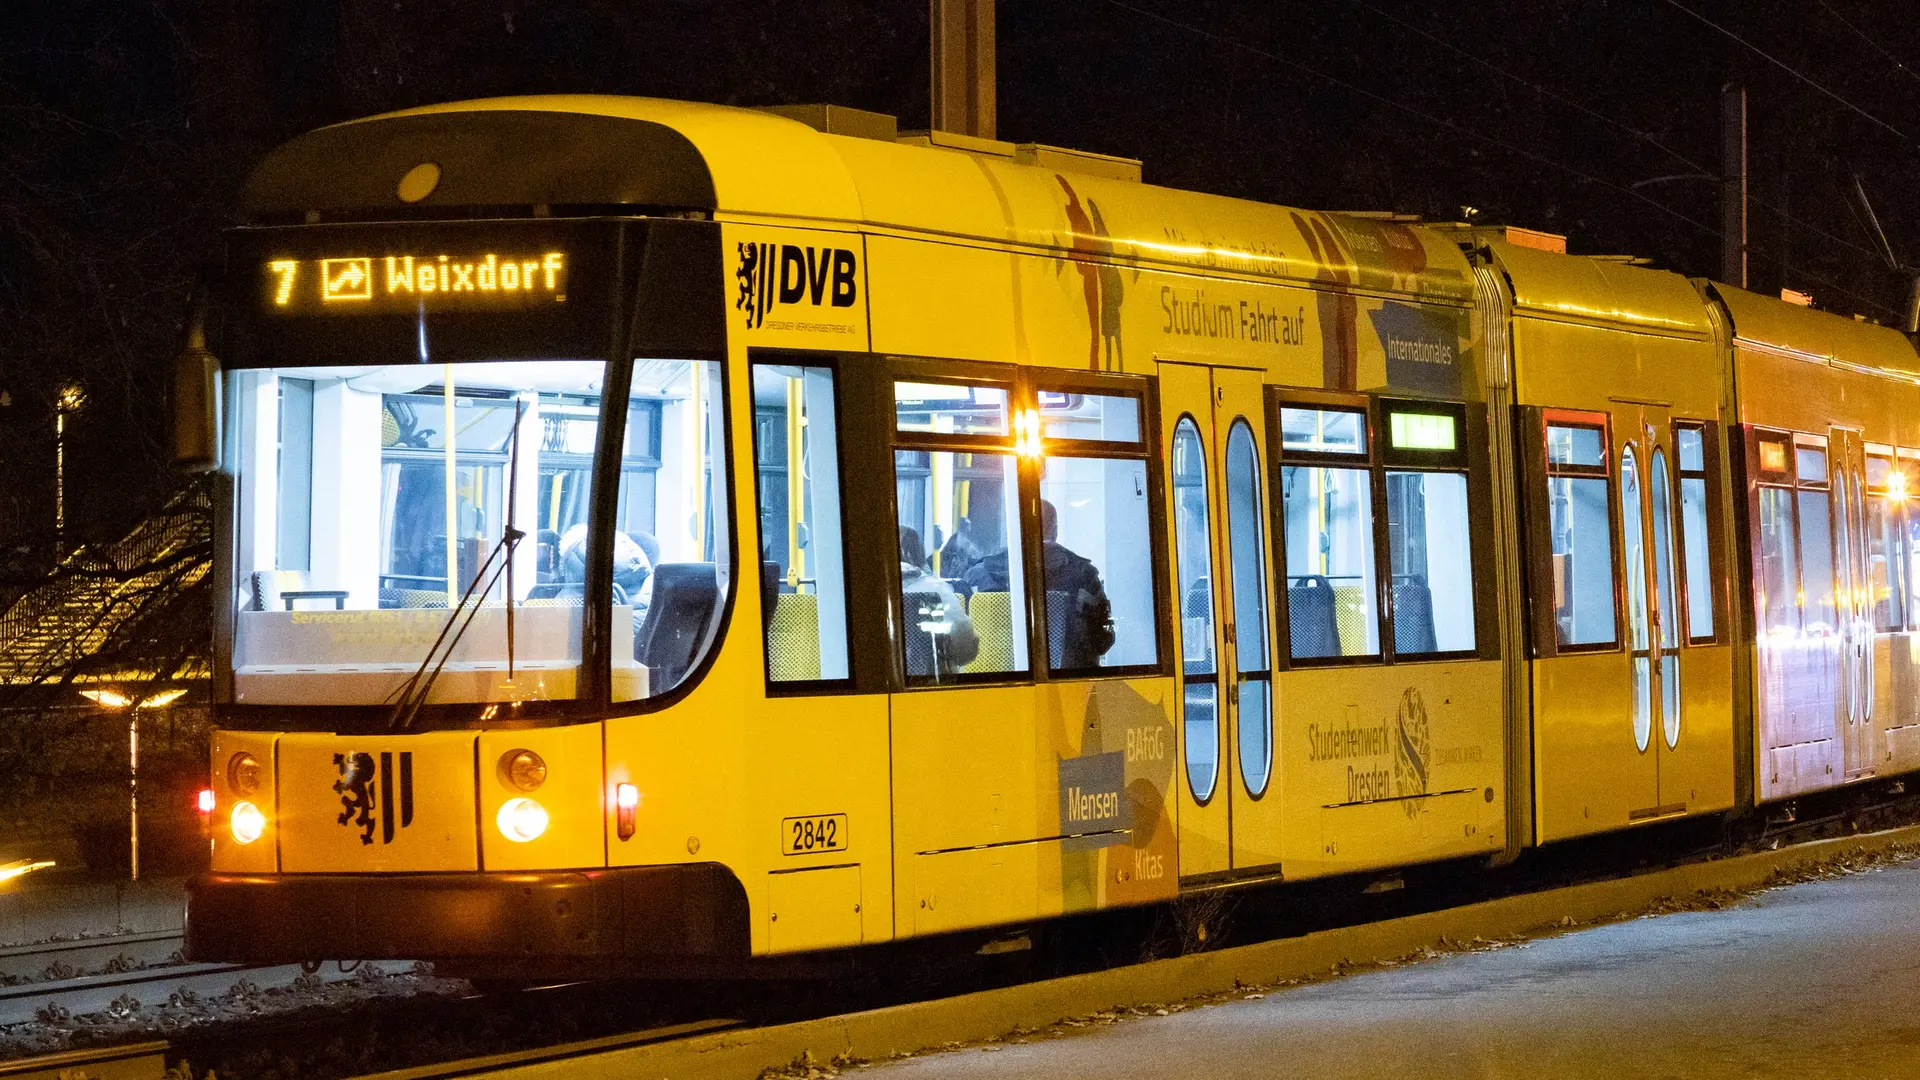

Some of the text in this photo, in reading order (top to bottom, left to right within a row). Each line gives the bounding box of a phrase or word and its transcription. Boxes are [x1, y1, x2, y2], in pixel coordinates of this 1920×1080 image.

[271, 254, 564, 304] 7 Weixdorf
[779, 244, 857, 308] DVB
[1160, 285, 1305, 346] Studium Fahrt auf
[1387, 333, 1452, 365] Internationales
[1127, 726, 1164, 762] BAföG
[1308, 718, 1390, 761] Studentenwerk
[1347, 763, 1390, 802] Dresden
[1068, 787, 1119, 822] Mensen
[793, 818, 837, 850] 2842
[1135, 850, 1164, 881] Kitas
